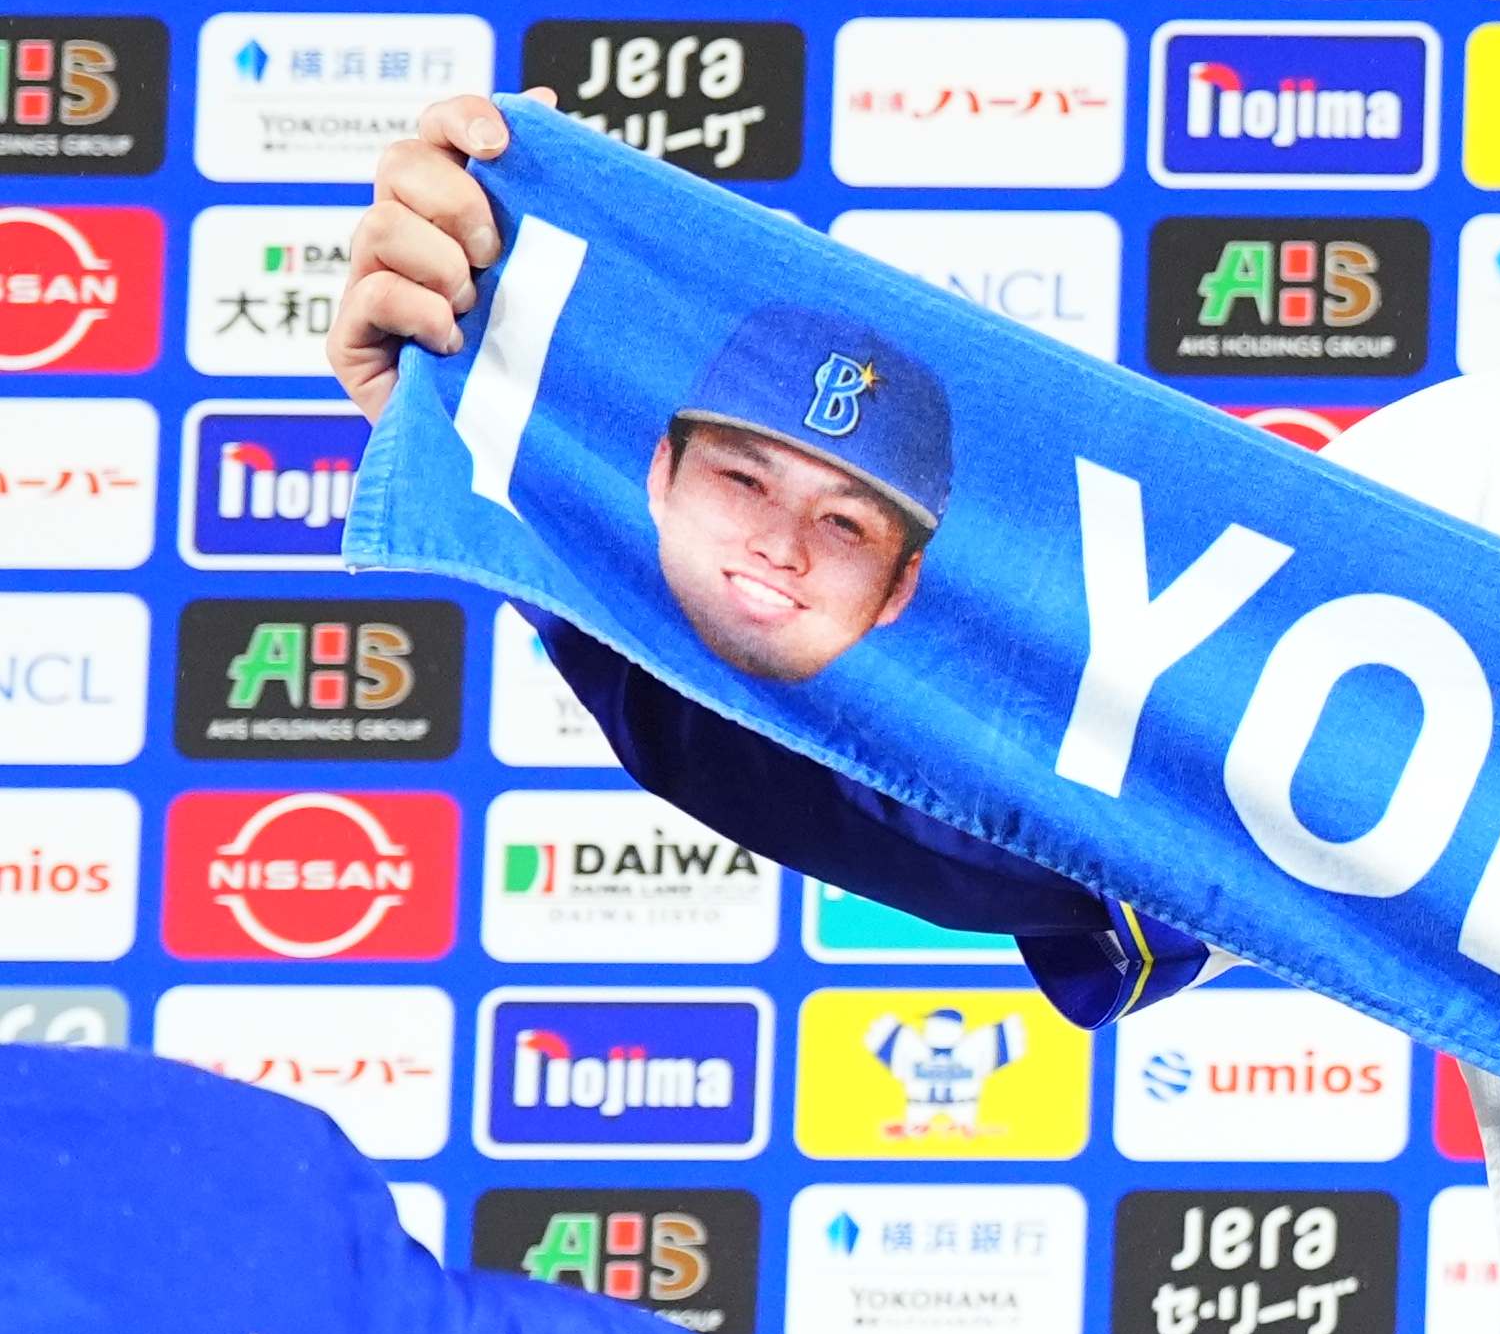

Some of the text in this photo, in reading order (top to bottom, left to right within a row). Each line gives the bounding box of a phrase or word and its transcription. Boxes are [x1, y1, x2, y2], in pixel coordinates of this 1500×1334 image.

[1327, 336, 1395, 357] GROUP
[209, 860, 412, 890] NISSAN
[880, 1221, 1044, 1254] 横浜銀行
